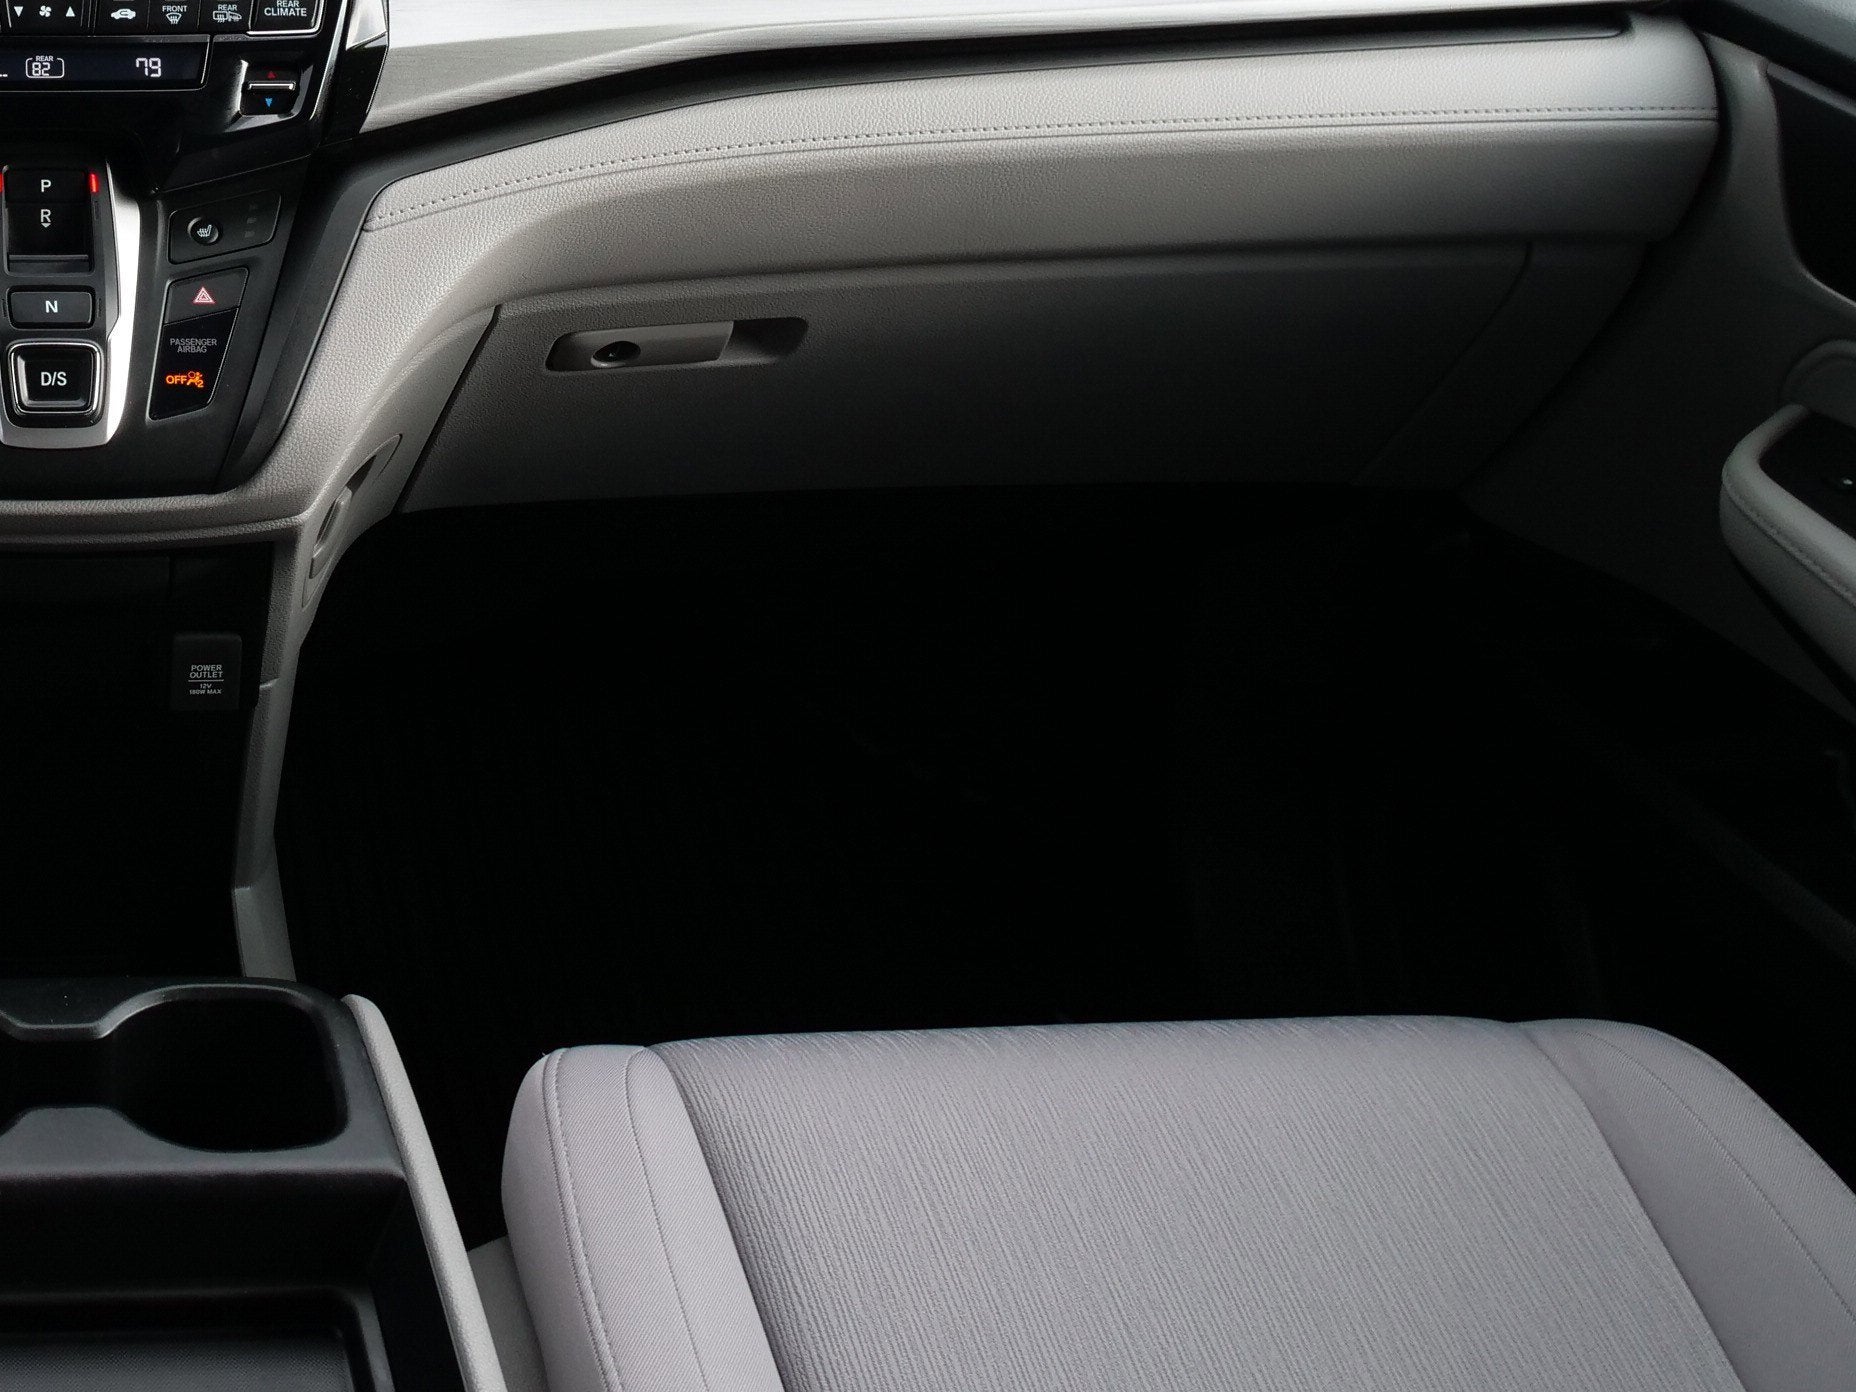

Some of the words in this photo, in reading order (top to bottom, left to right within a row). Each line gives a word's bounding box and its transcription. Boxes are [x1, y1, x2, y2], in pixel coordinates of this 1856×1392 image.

[161, 4, 188, 13] FRONT
[217, 4, 238, 12] REAR
[276, 0, 300, 8] REAR
[263, 7, 308, 17] CLIMATE
[35, 54, 54, 62] REAR
[31, 61, 51, 77] 82
[40, 178, 52, 193] P
[40, 208, 52, 223] R
[45, 300, 59, 314] N
[169, 338, 218, 347] PASSENGER
[177, 345, 208, 354] AIRBAG
[40, 370, 68, 387] D/S
[165, 374, 187, 385] OFF
[190, 664, 223, 672] POWER
[189, 671, 224, 679] OUTLET
